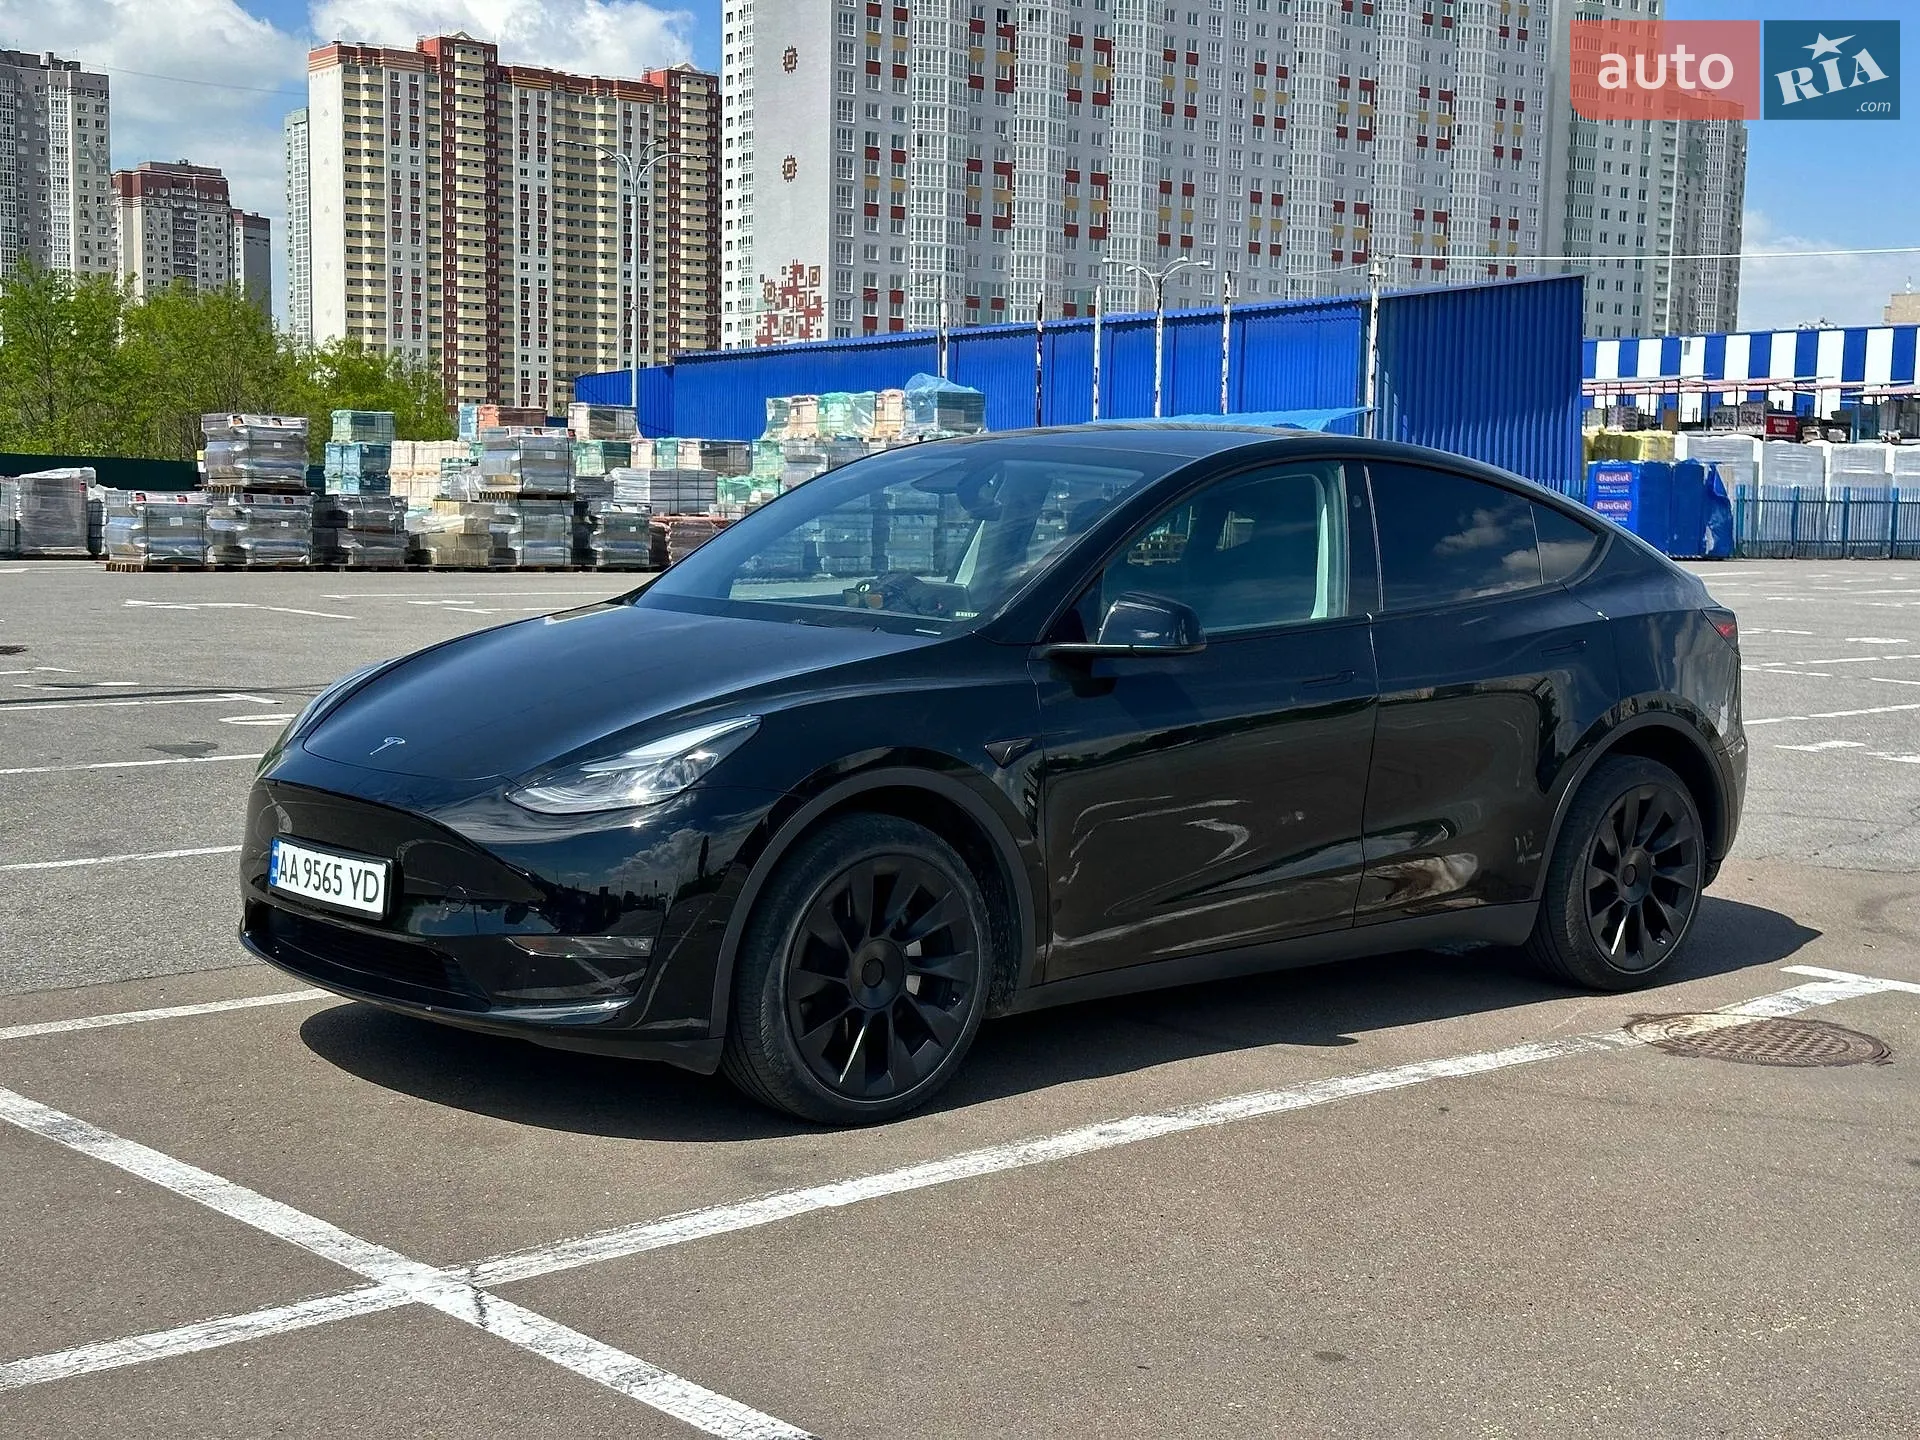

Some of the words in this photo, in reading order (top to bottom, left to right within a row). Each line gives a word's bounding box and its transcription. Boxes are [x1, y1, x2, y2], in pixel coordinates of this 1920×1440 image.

[1596, 501, 1630, 511] BauGut
[279, 850, 299, 886] AA
[304, 857, 342, 896] 9565
[350, 866, 379, 903] YD
